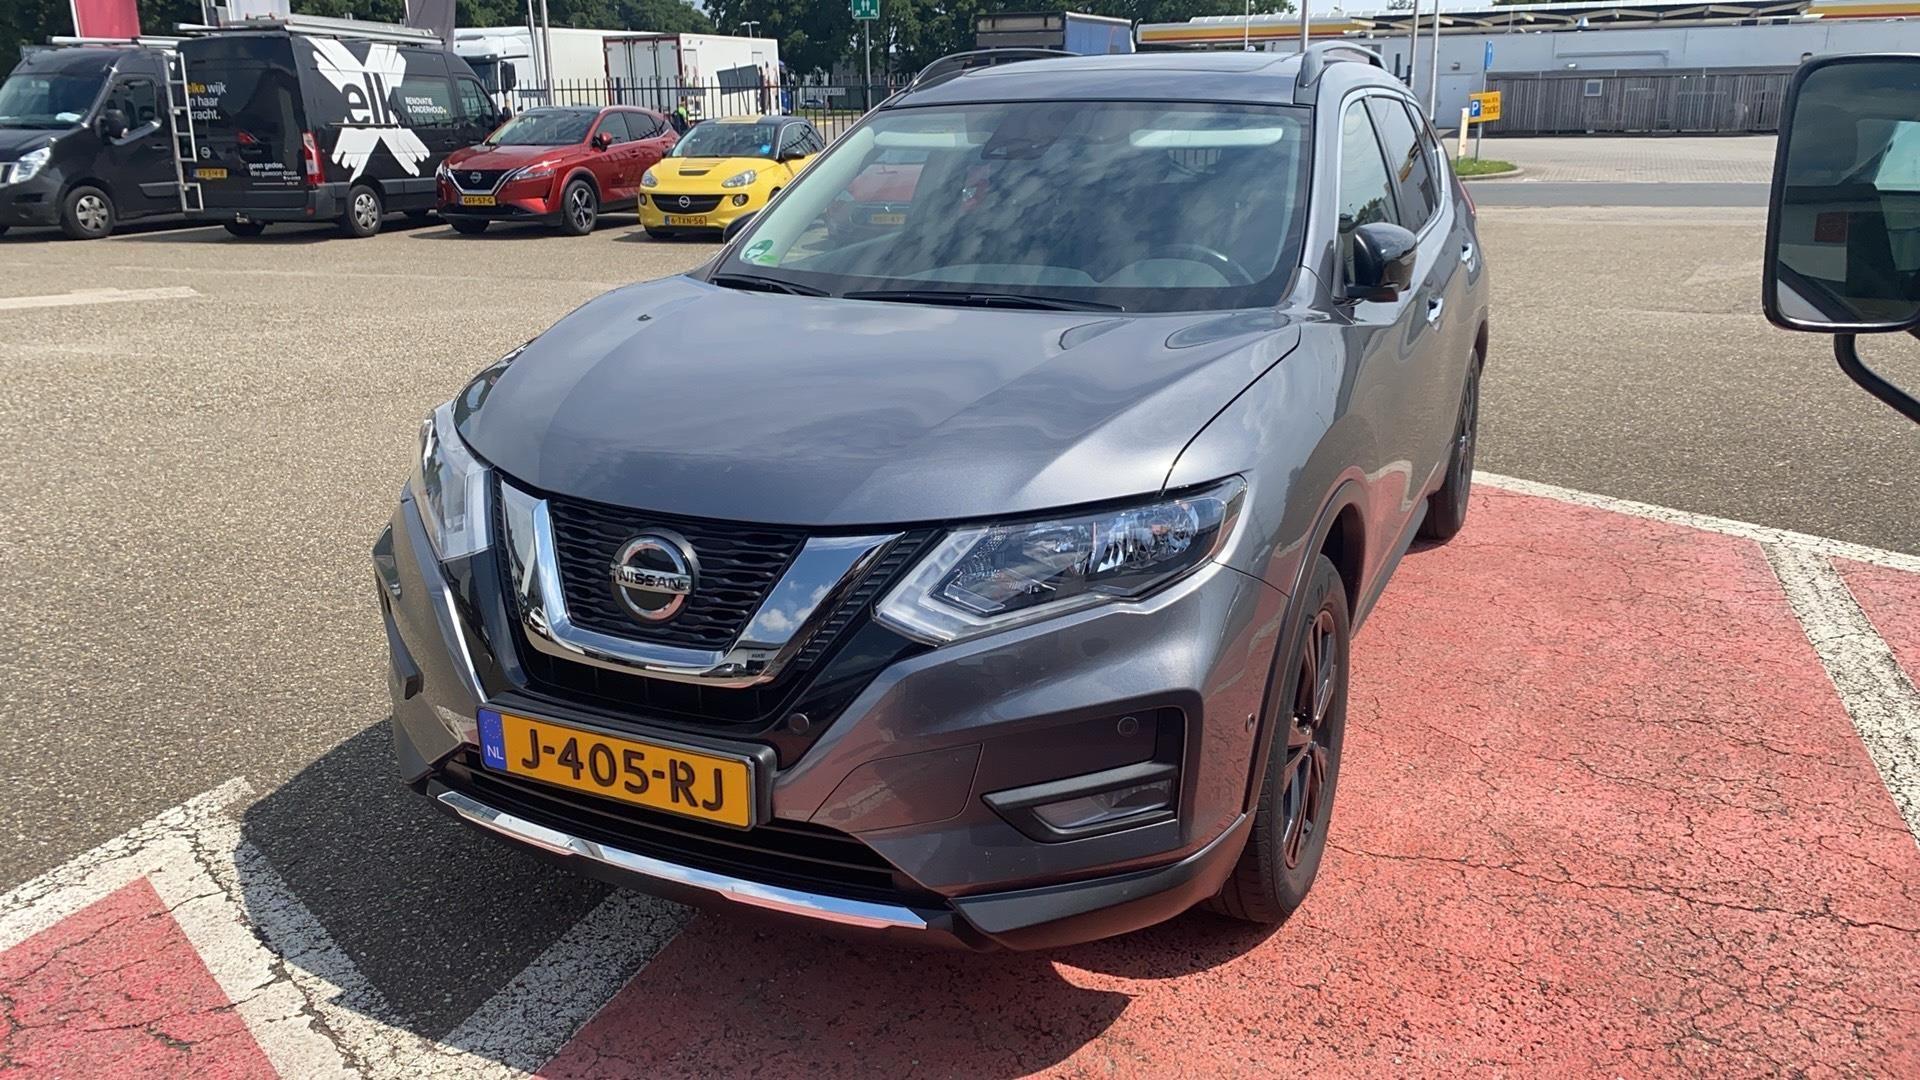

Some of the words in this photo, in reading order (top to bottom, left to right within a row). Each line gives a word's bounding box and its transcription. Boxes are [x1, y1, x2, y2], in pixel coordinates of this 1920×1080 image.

[206, 81, 227, 96] wijk
[197, 95, 218, 107] haar
[341, 71, 400, 128] elk
[618, 569, 681, 591] NISSAN
[487, 744, 504, 760] NL
[521, 728, 724, 812] J-405-RJ
